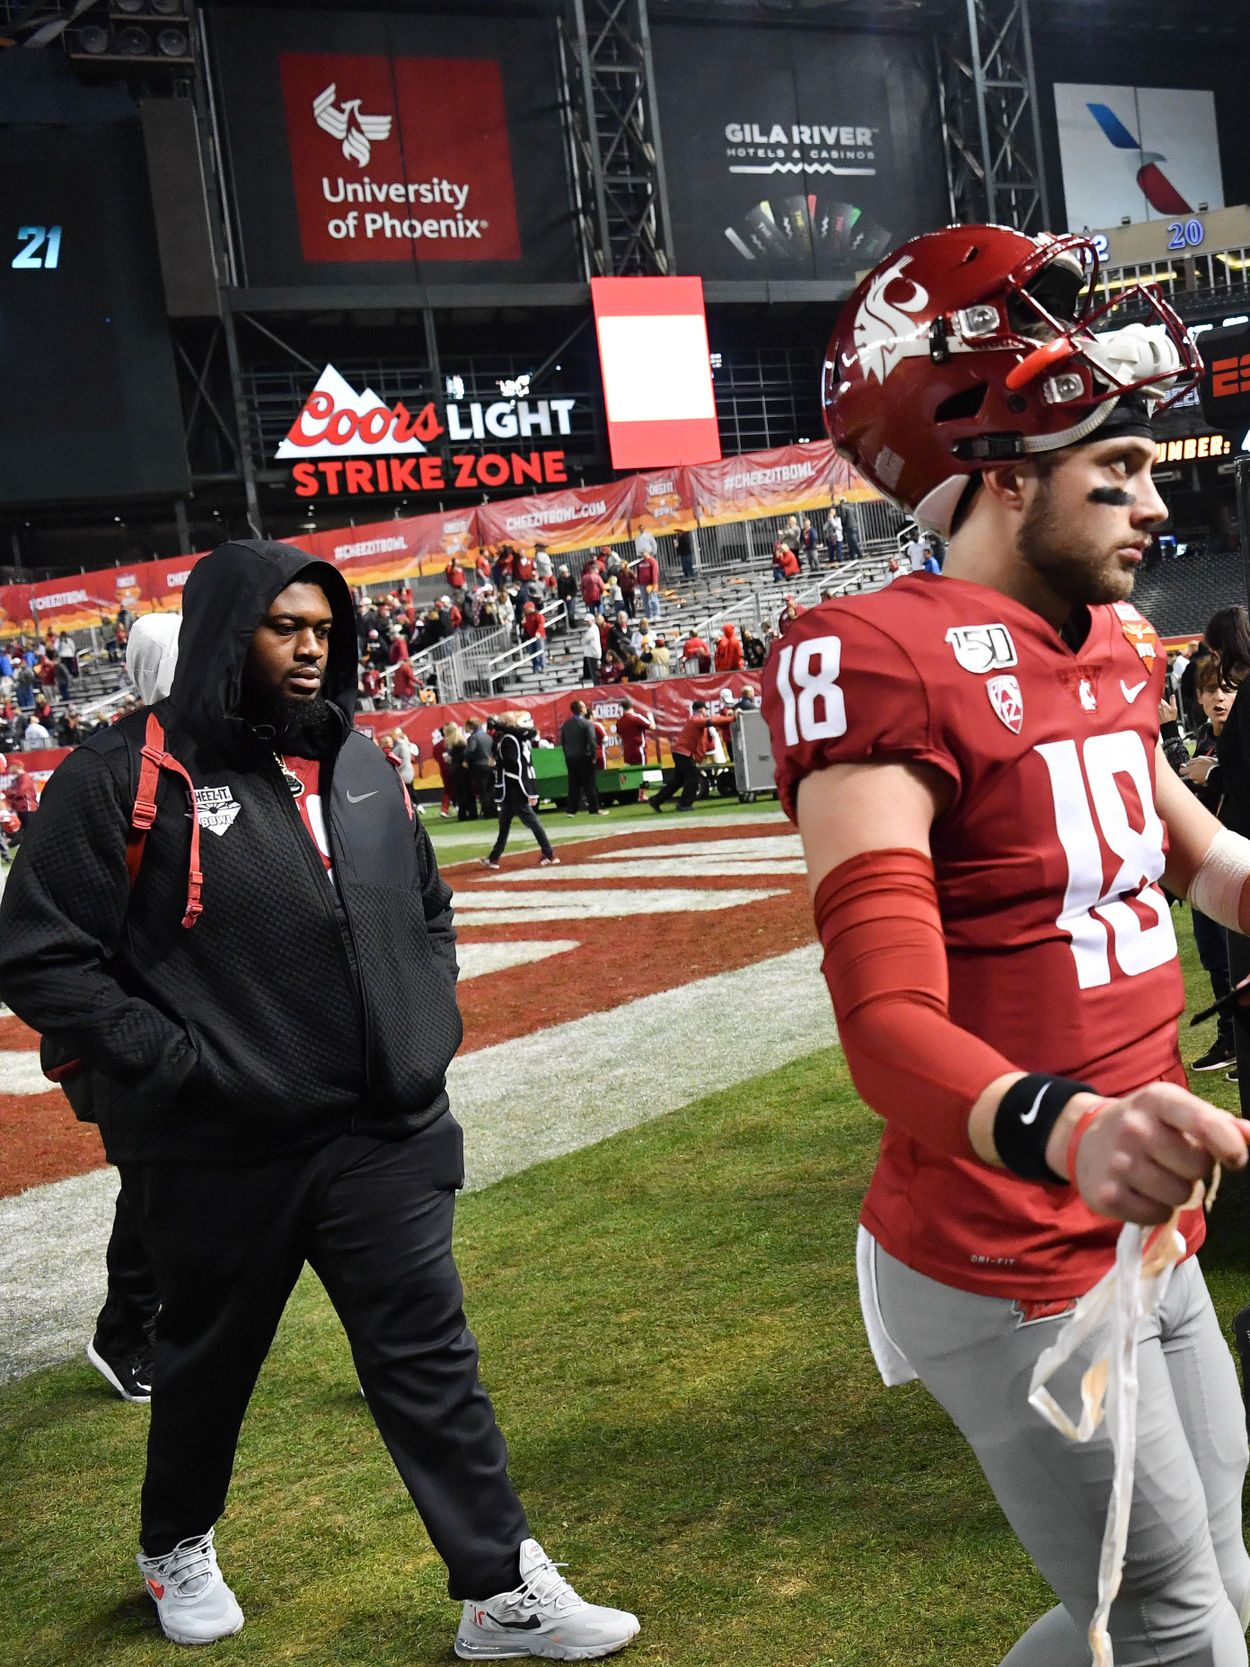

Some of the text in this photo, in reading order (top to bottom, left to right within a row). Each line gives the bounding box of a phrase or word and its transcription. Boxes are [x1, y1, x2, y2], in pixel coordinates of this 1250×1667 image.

[724, 123, 874, 146] GILA RIVER
[726, 148, 785, 158] HOTELS
[809, 149, 876, 160] CASINOS
[322, 176, 470, 211] University
[327, 210, 359, 240] of
[1167, 218, 1205, 250] 20
[11, 225, 62, 269] 21
[287, 391, 576, 447] Coors LIGHT
[292, 450, 568, 497] STRIKE ZONE
[723, 461, 816, 492] #CHEEZITBOWL
[504, 500, 607, 532] CHEEZITBOWL.COM
[776, 635, 847, 746] 18
[200, 814, 234, 829] BOWL
[1033, 730, 1178, 990] 18
[970, 1254, 1016, 1265] DRI-FIT
